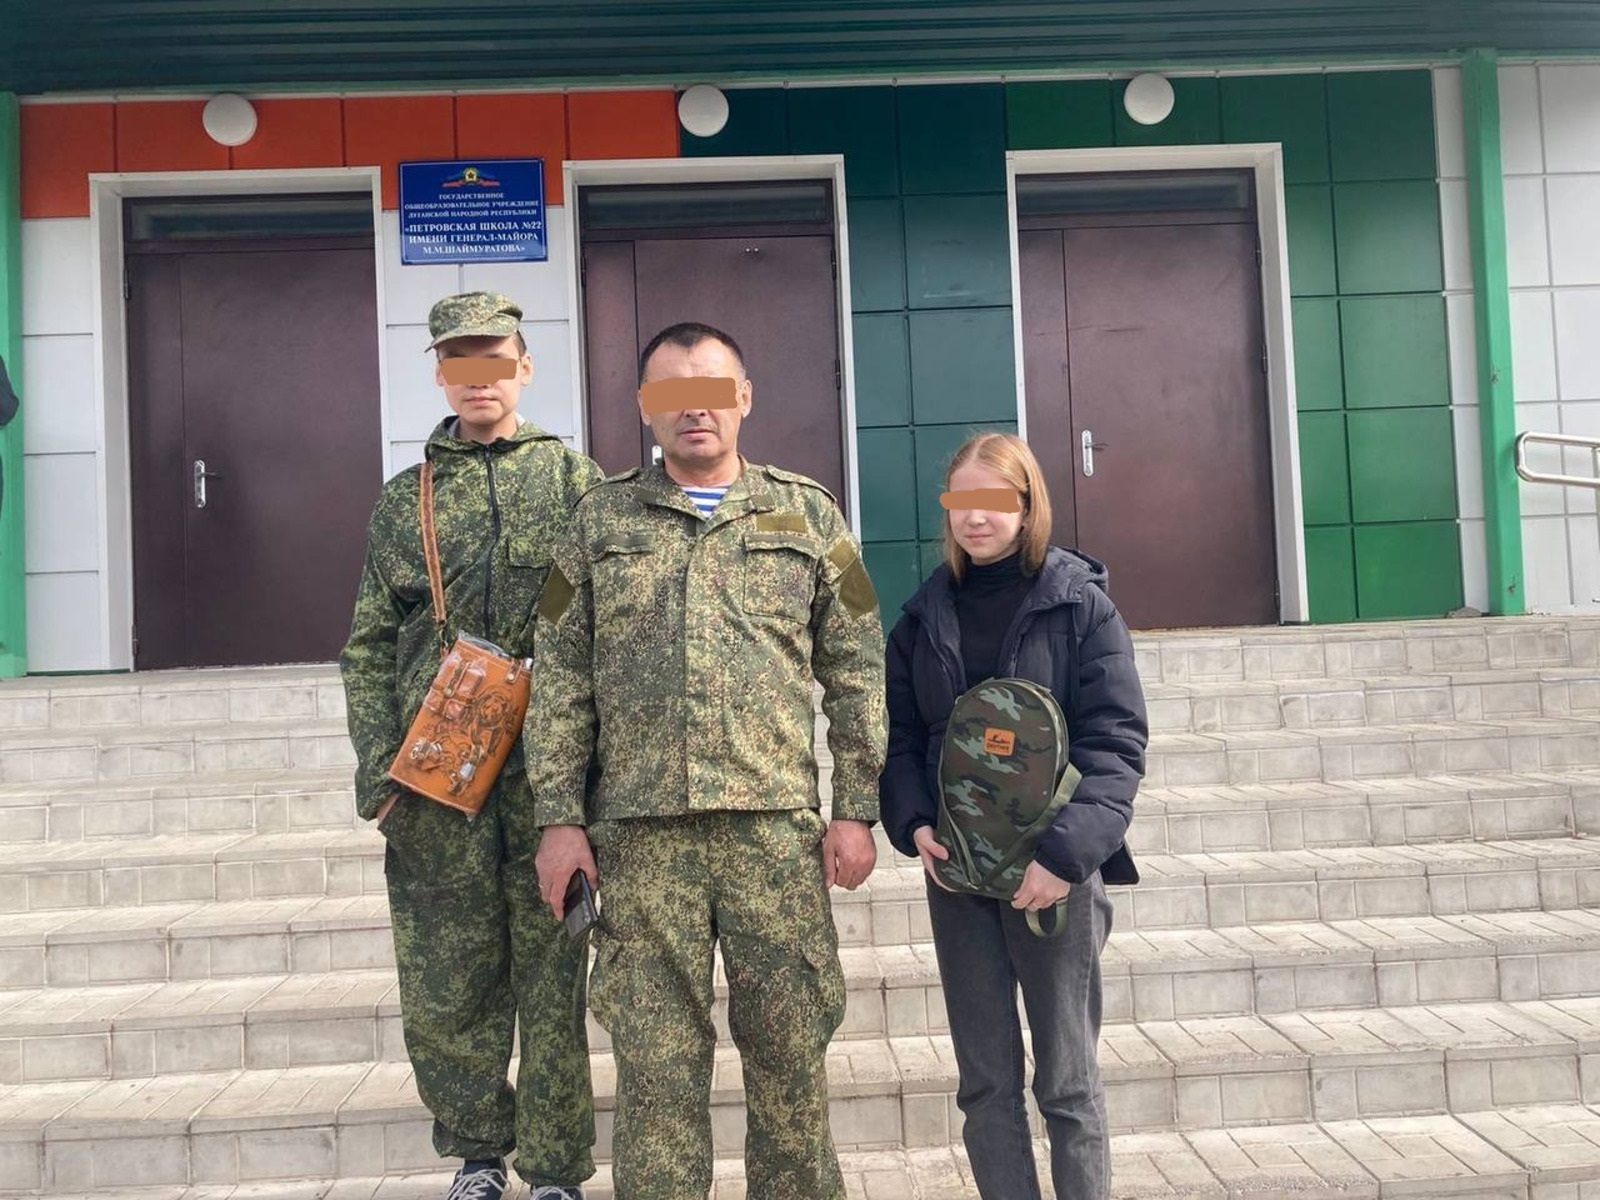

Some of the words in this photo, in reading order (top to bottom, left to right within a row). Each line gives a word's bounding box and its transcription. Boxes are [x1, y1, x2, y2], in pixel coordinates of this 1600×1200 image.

[439, 192, 504, 200] ГОСУДАРСТВЕННОЕ
[450, 209, 489, 218] НАРОДНОЙ
[490, 209, 537, 217] РЕСПУБЛИКИ
[404, 222, 477, 233] «ПЕТРОВСКАЯ
[480, 221, 519, 231] ШКОЛА
[521, 220, 542, 230] №22
[409, 234, 447, 244] ИМЕНИ
[450, 232, 538, 243] ГЕНЕРАЛ-МАЙОРА
[423, 244, 526, 255] М.М.ШАЙМУРАТОВА»
